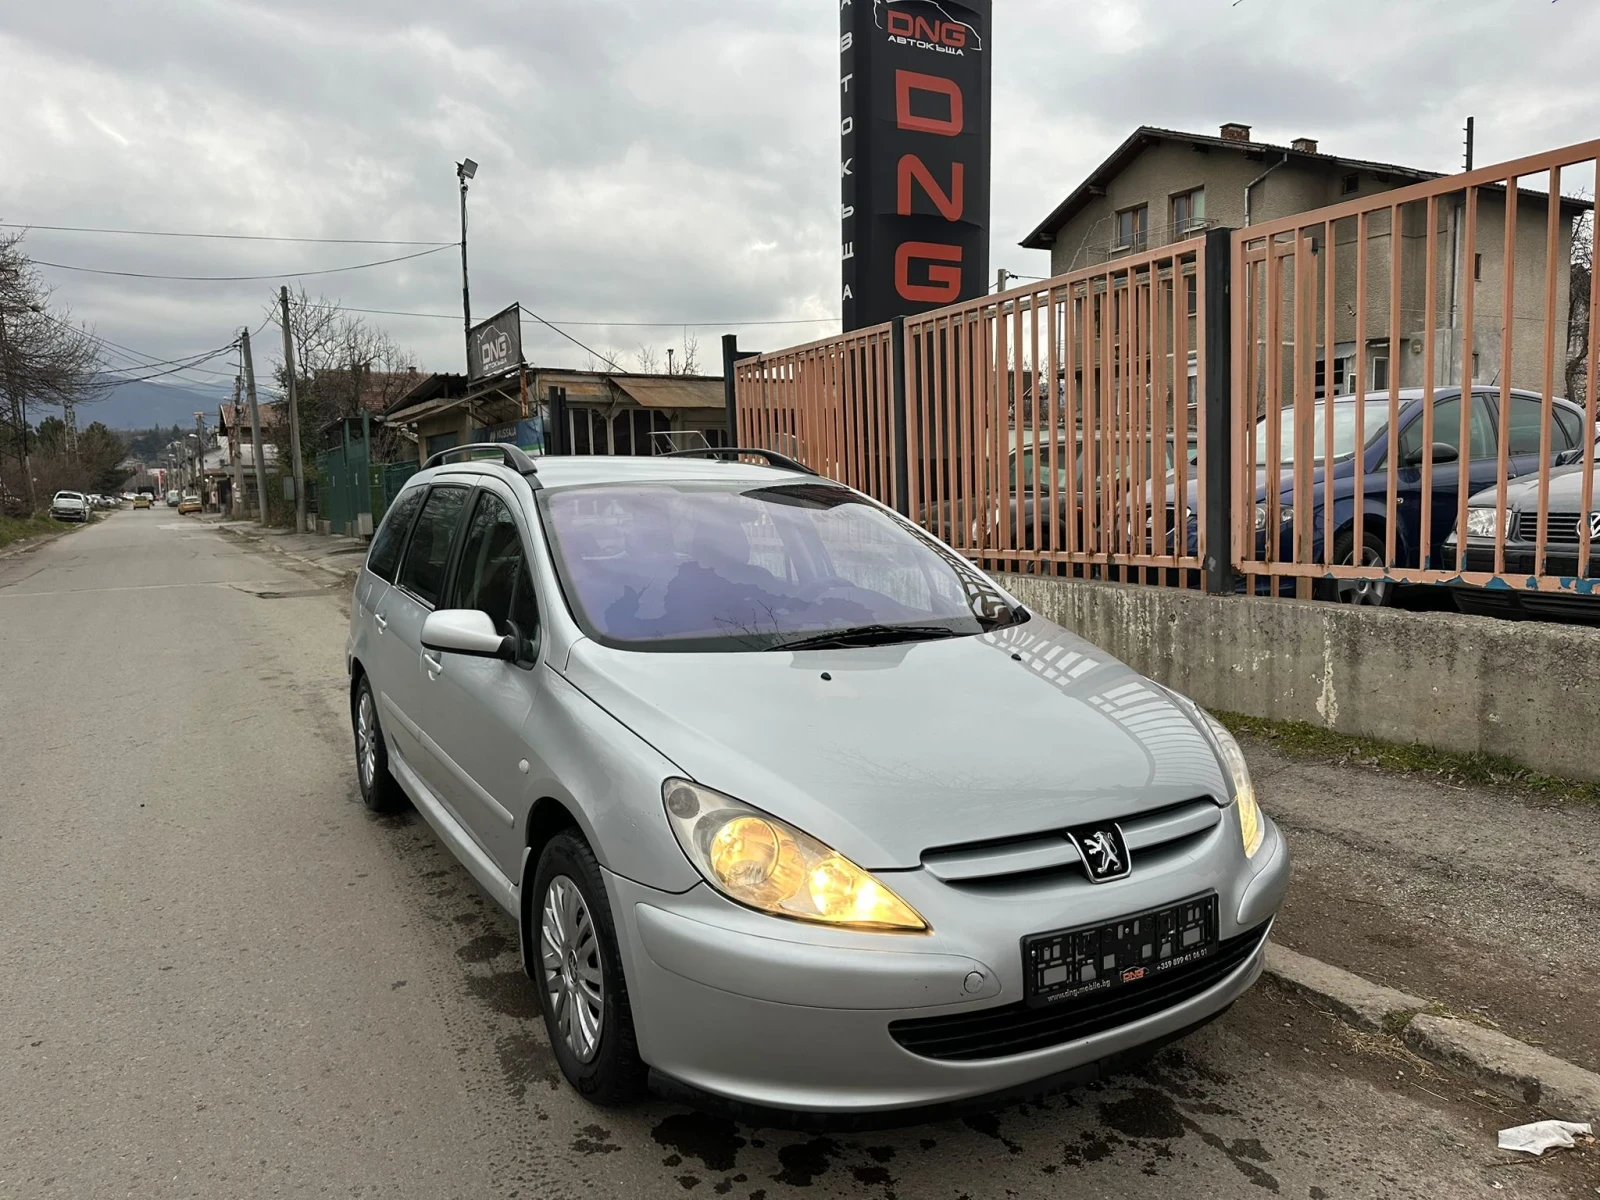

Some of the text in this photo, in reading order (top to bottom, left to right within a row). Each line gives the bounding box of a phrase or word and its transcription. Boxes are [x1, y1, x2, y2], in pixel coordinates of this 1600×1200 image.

[887, 10, 966, 48] DNG
[887, 35, 965, 56] АВТОКЪЩА
[895, 69, 963, 303] DNG
[482, 335, 507, 365] DNG
[1123, 968, 1145, 981] DNG
